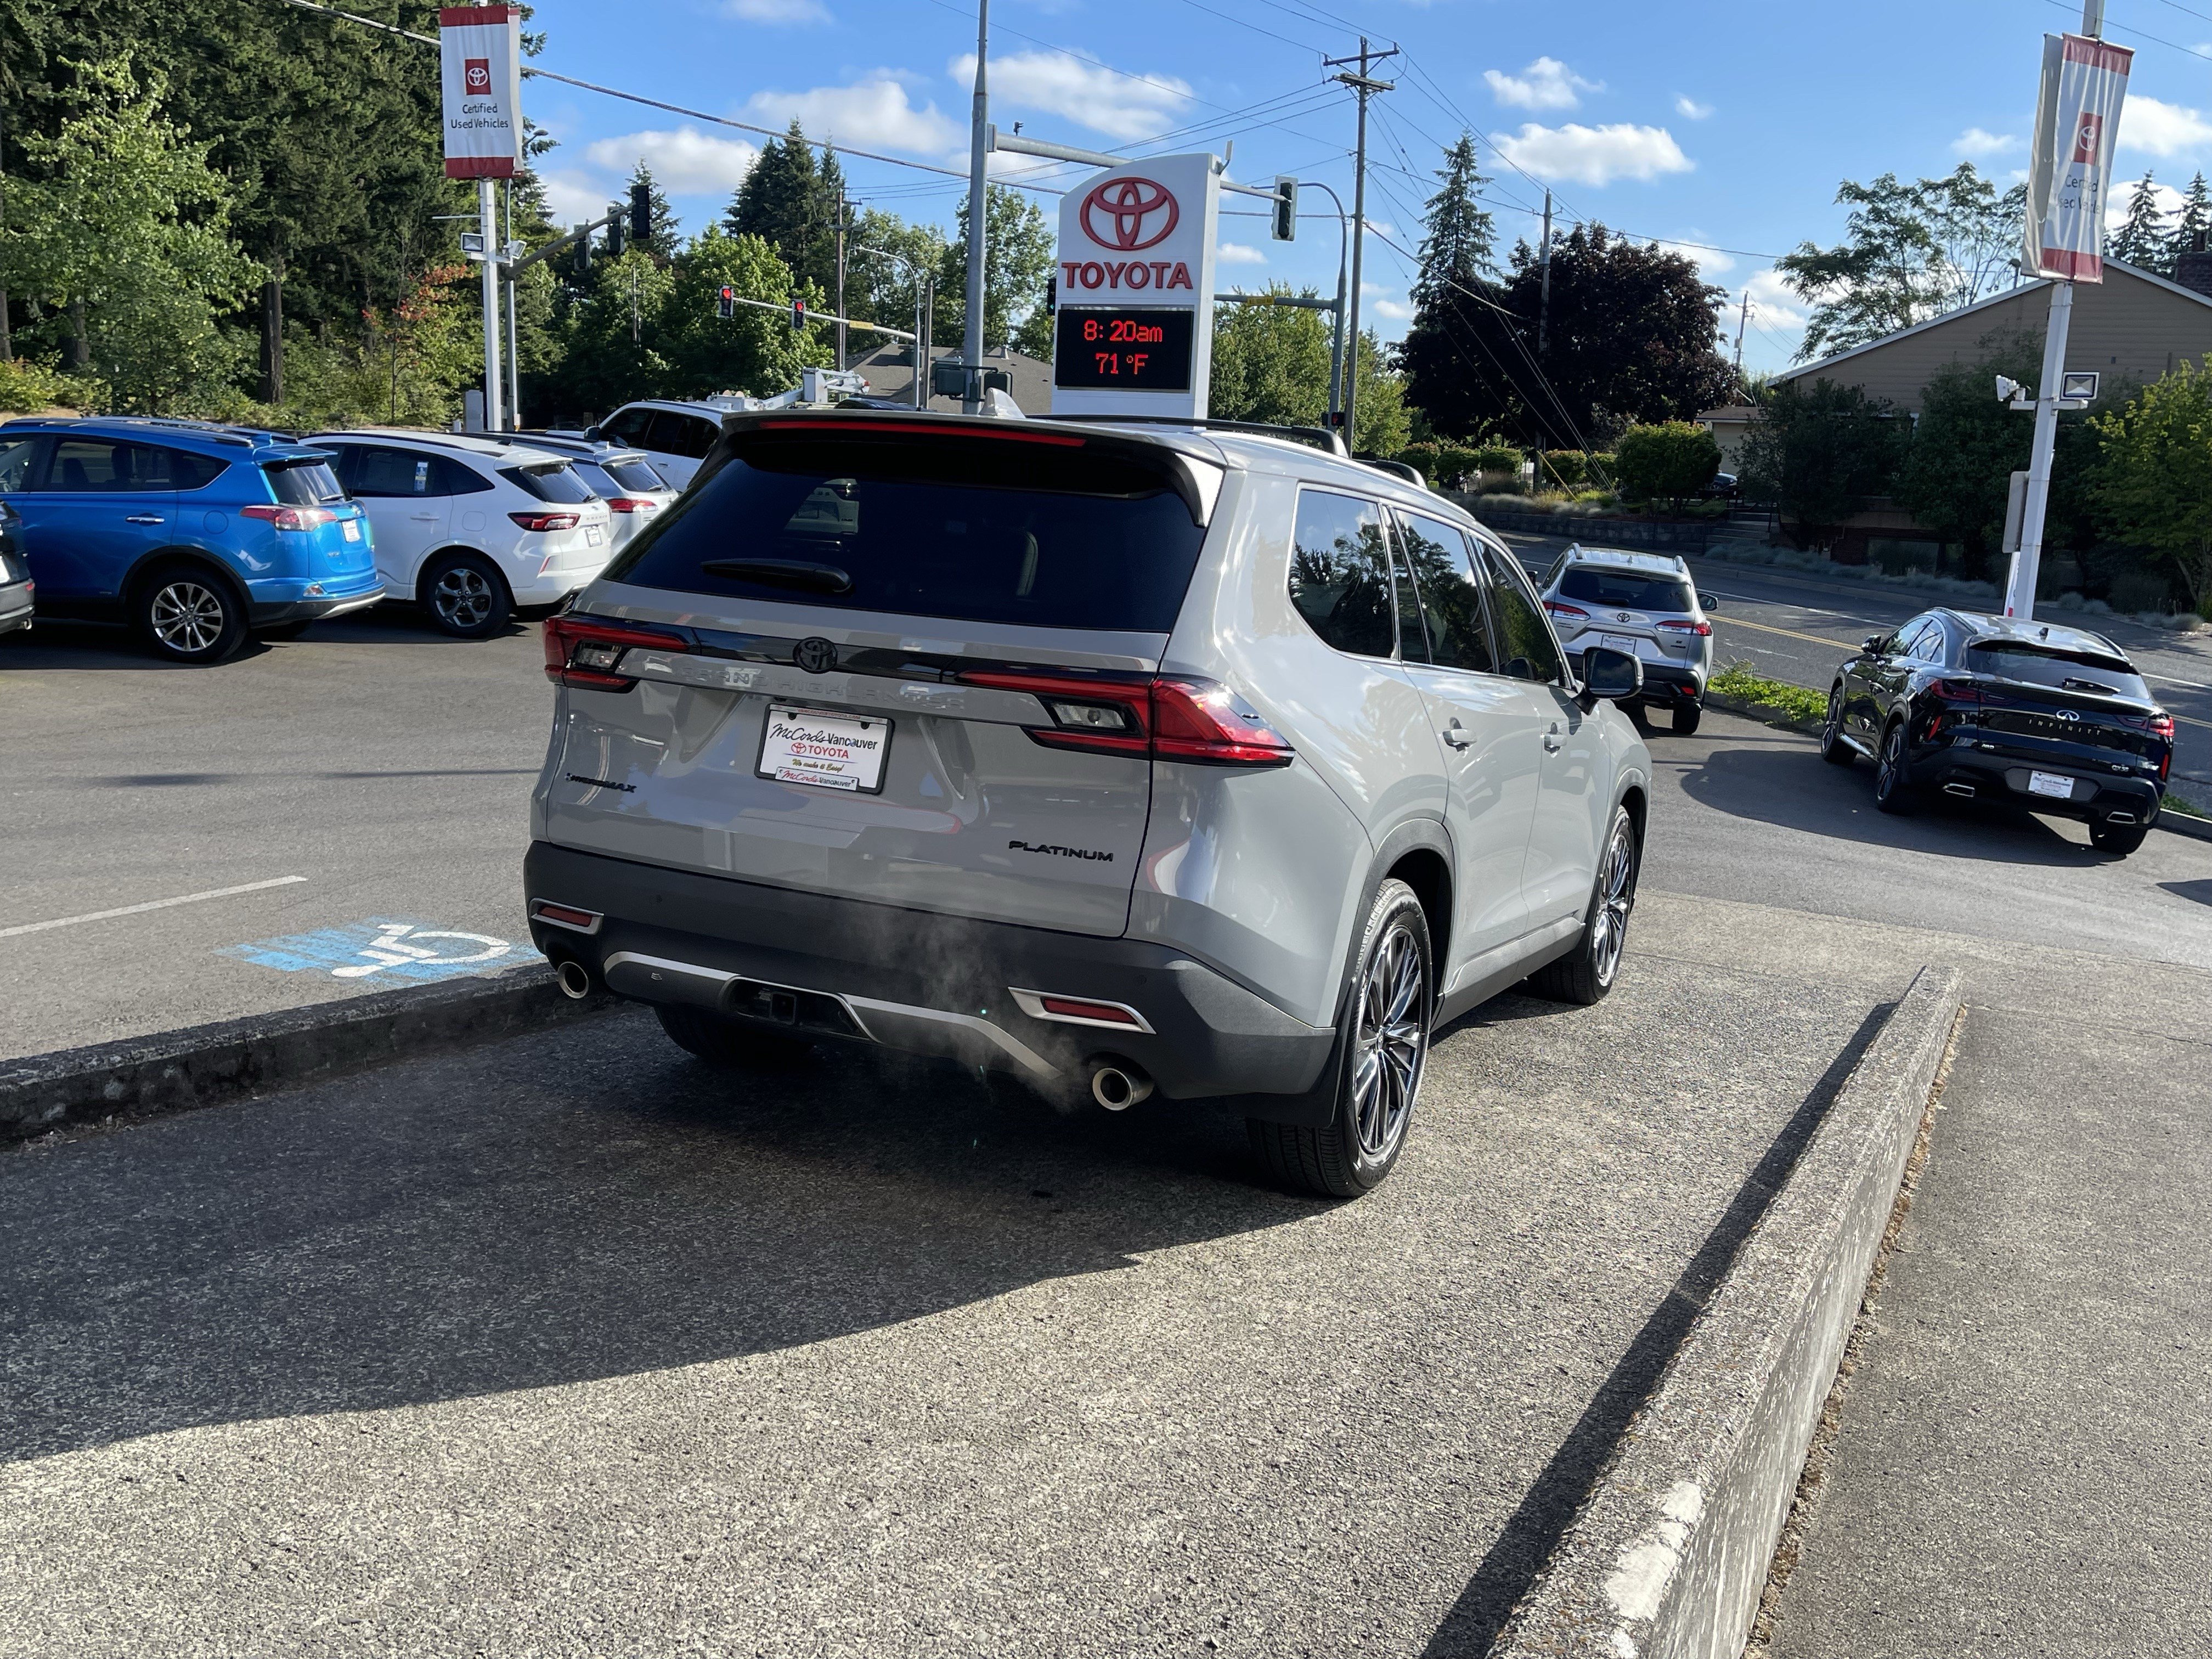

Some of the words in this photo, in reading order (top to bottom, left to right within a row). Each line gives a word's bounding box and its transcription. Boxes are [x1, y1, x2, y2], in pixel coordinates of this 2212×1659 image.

[450, 118, 473, 129] Used
[473, 117, 509, 128] Vehicles
[1061, 261, 1193, 290] TOYOTA
[1084, 320, 1163, 342] 8:20am
[1095, 353, 1119, 374] 71
[769, 723, 828, 743] McCords
[828, 732, 878, 750] Vancouver
[808, 744, 849, 759] TOYOTA
[819, 776, 851, 788] Vancouver
[1008, 840, 1114, 862] PLATINUM
